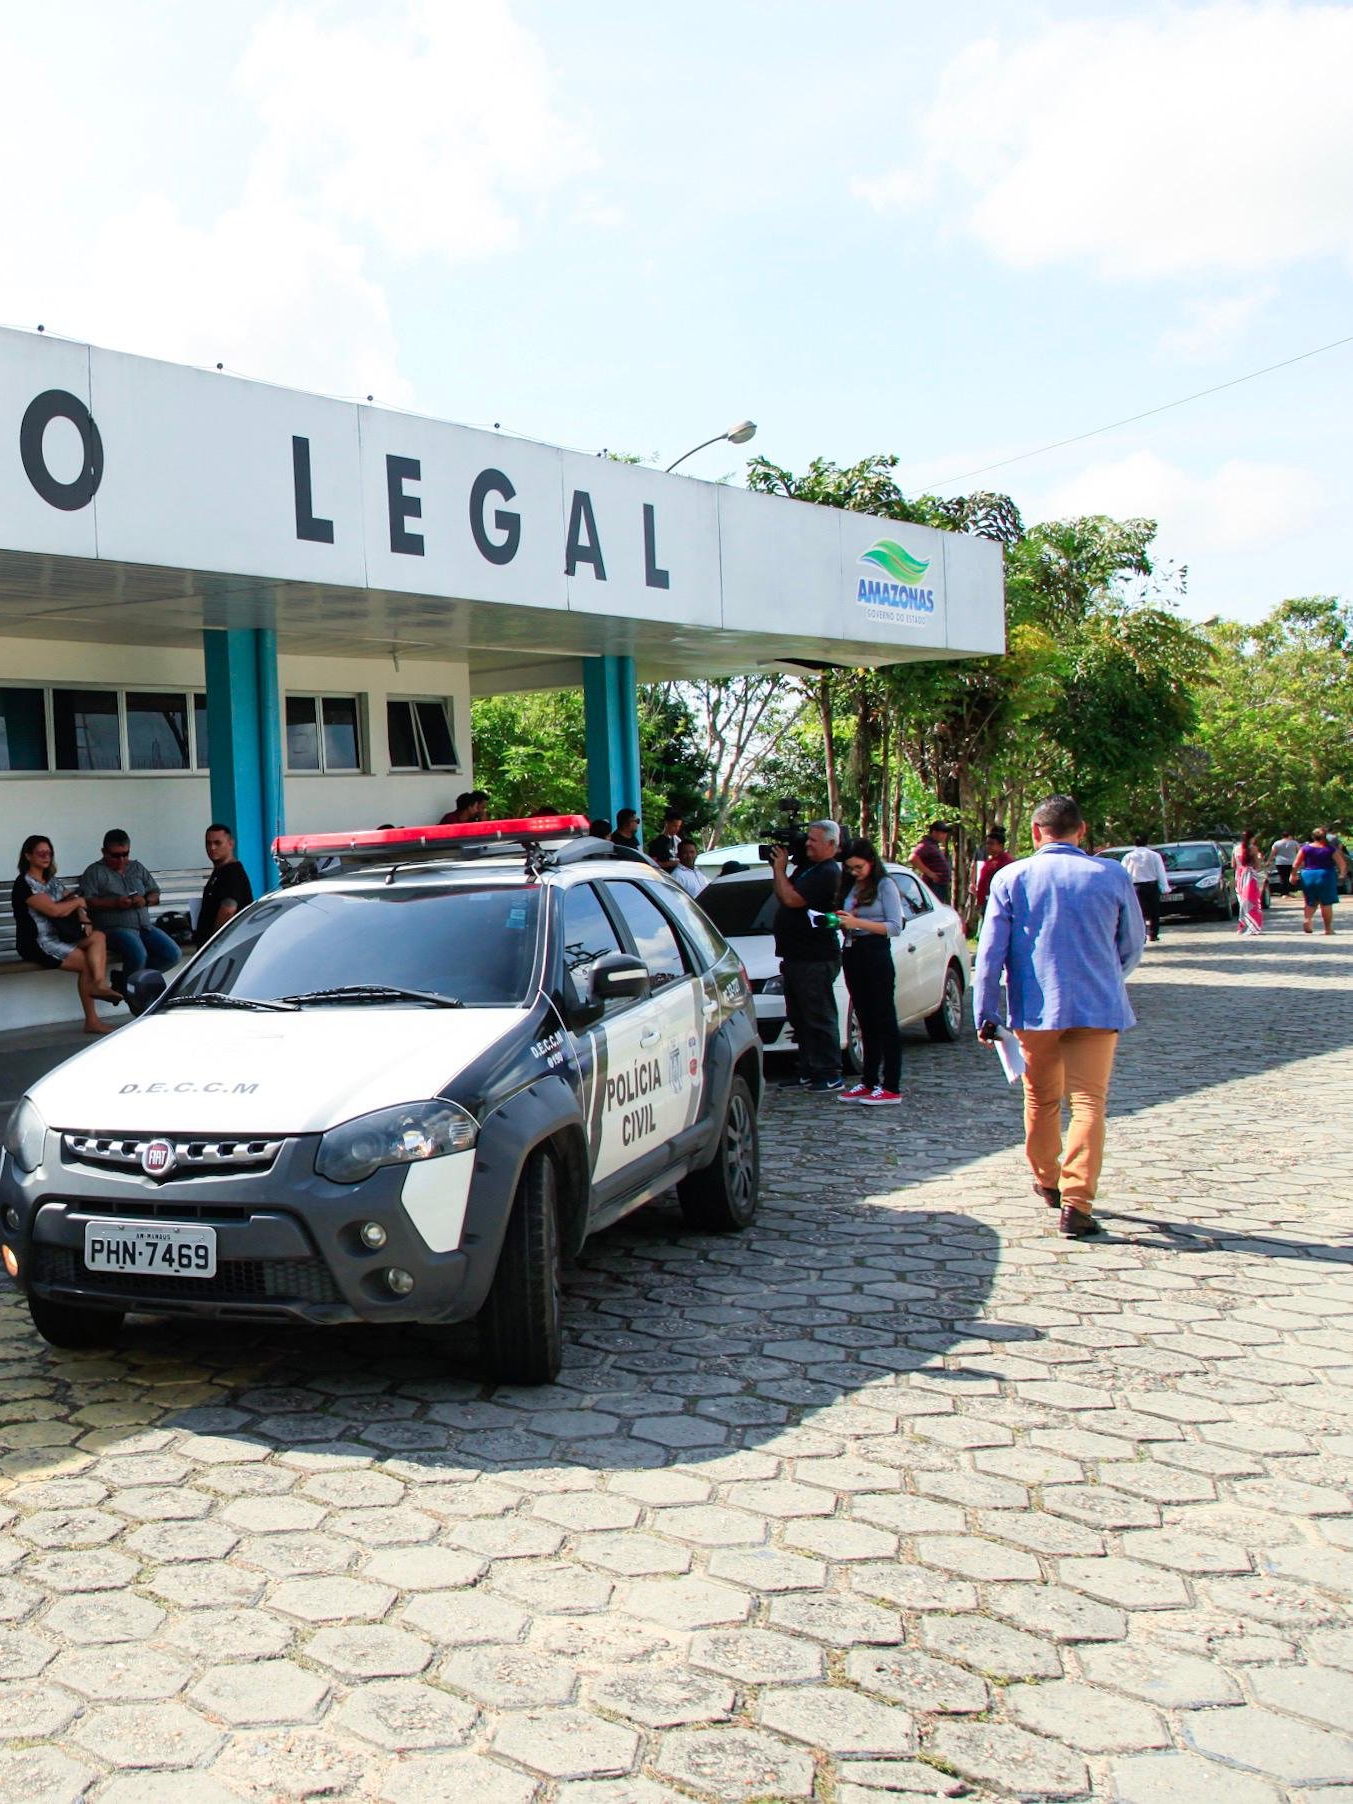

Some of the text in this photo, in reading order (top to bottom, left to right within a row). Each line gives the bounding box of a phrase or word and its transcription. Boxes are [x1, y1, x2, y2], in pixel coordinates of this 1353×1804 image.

[292, 435, 670, 590] LEGAL
[857, 578, 935, 614] AMAZONAS
[867, 609, 926, 625] GOVERNO DO ESTADO
[118, 1082, 260, 1095] D.E.C.C.M
[606, 1058, 662, 1112] POLÍCIA
[622, 1103, 657, 1147] CIVIL
[148, 1149, 167, 1165] FIAT
